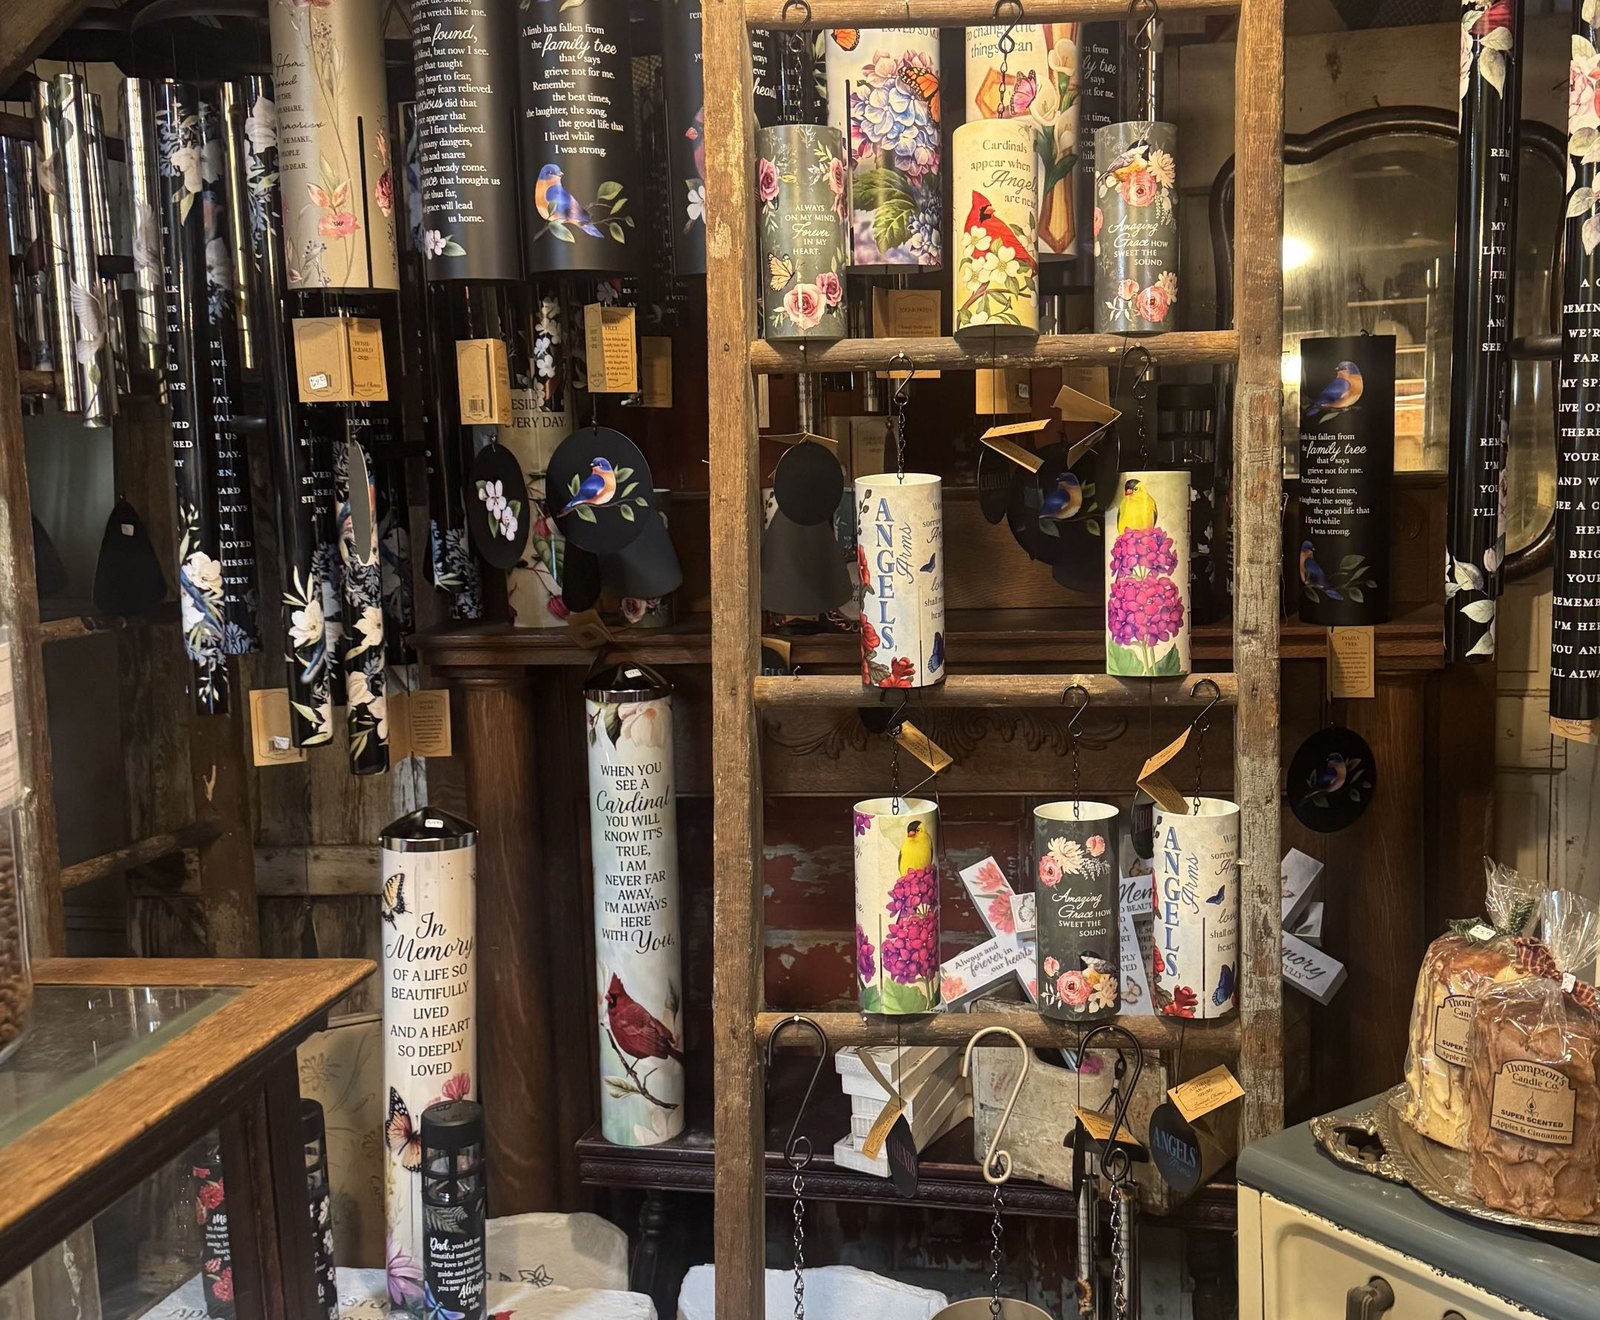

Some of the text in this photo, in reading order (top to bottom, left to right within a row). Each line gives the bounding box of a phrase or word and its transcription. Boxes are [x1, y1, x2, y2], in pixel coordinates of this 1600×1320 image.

[428, 6, 486, 17] wretch like me.
[432, 23, 478, 46] found,
[544, 23, 604, 34] has fallen from
[434, 47, 446, 56] but
[531, 33, 617, 60] the family tree
[559, 53, 600, 65] that says
[426, 74, 442, 83] heart
[454, 71, 472, 82] fear,
[544, 67, 569, 78] grieve
[572, 68, 586, 76] not
[588, 67, 600, 76] for
[438, 83, 493, 94] fears relieved.
[532, 80, 576, 91] Remember
[552, 92, 611, 105] the best times,
[536, 105, 608, 118] laughter, the song,
[450, 124, 486, 134] believed.
[558, 119, 624, 132] the good life that
[544, 132, 594, 142] I lived while
[555, 144, 560, 154] I
[982, 140, 1028, 154] Cardinals
[434, 163, 460, 174] already
[971, 158, 1030, 172] appear when
[440, 176, 454, 185] that
[456, 176, 489, 186] brought
[440, 201, 473, 210] will lead
[1004, 195, 1020, 204] are
[458, 213, 484, 222] home.
[792, 222, 830, 240] Forever
[1108, 214, 1158, 237] Amazing
[1114, 232, 1149, 248] Grace
[1114, 250, 1140, 258] SWEET
[1574, 354, 1600, 362] FAR
[1562, 379, 1578, 388] MY
[542, 416, 567, 428] DAY.
[1306, 440, 1368, 462] family tree
[1558, 477, 1582, 486] AND
[1576, 502, 1586, 510] A
[896, 522, 914, 584] Arms
[1554, 621, 1572, 630] I'M
[600, 762, 662, 776] WHEN YOU
[616, 778, 650, 790] SEE A
[596, 784, 670, 814] Cardinal
[606, 814, 660, 827] YOU WILL
[604, 827, 663, 842] KNOW IT'S
[616, 845, 650, 856] TRUE,
[626, 860, 646, 872] AM
[606, 870, 666, 886] NEVER FAR
[1182, 852, 1200, 914] Arms
[618, 888, 654, 900] AWAY,
[1052, 888, 1102, 910] Amazing
[604, 898, 668, 914] I'M ALWAYS
[1058, 904, 1112, 918] Grace HOW
[416, 912, 446, 940] In
[620, 915, 652, 928] HERE
[1079, 928, 1106, 936] SOUND
[602, 928, 675, 954] WITH You.
[385, 934, 474, 962] Memory
[955, 942, 998, 969] Always and
[964, 947, 1012, 977] forever in
[992, 946, 1032, 972] our hearts
[393, 963, 468, 982] OF A LIFE SO
[392, 980, 469, 1000] BEAUTIFULLY
[414, 1006, 449, 1020] LIVED
[390, 1018, 470, 1038] AND A HEART
[398, 1039, 464, 1058] SO DEEPLY
[1442, 1040, 1464, 1052] SUPER
[411, 1062, 452, 1076] LOVED
[1506, 1062, 1567, 1086] Thompson's
[1512, 1073, 1543, 1088] Candle
[1546, 1080, 1560, 1090] Co.
[1501, 1109, 1564, 1128] SUPER SCENTED
[1496, 1119, 1519, 1132] Apples
[1528, 1128, 1568, 1140] Cinnamon
